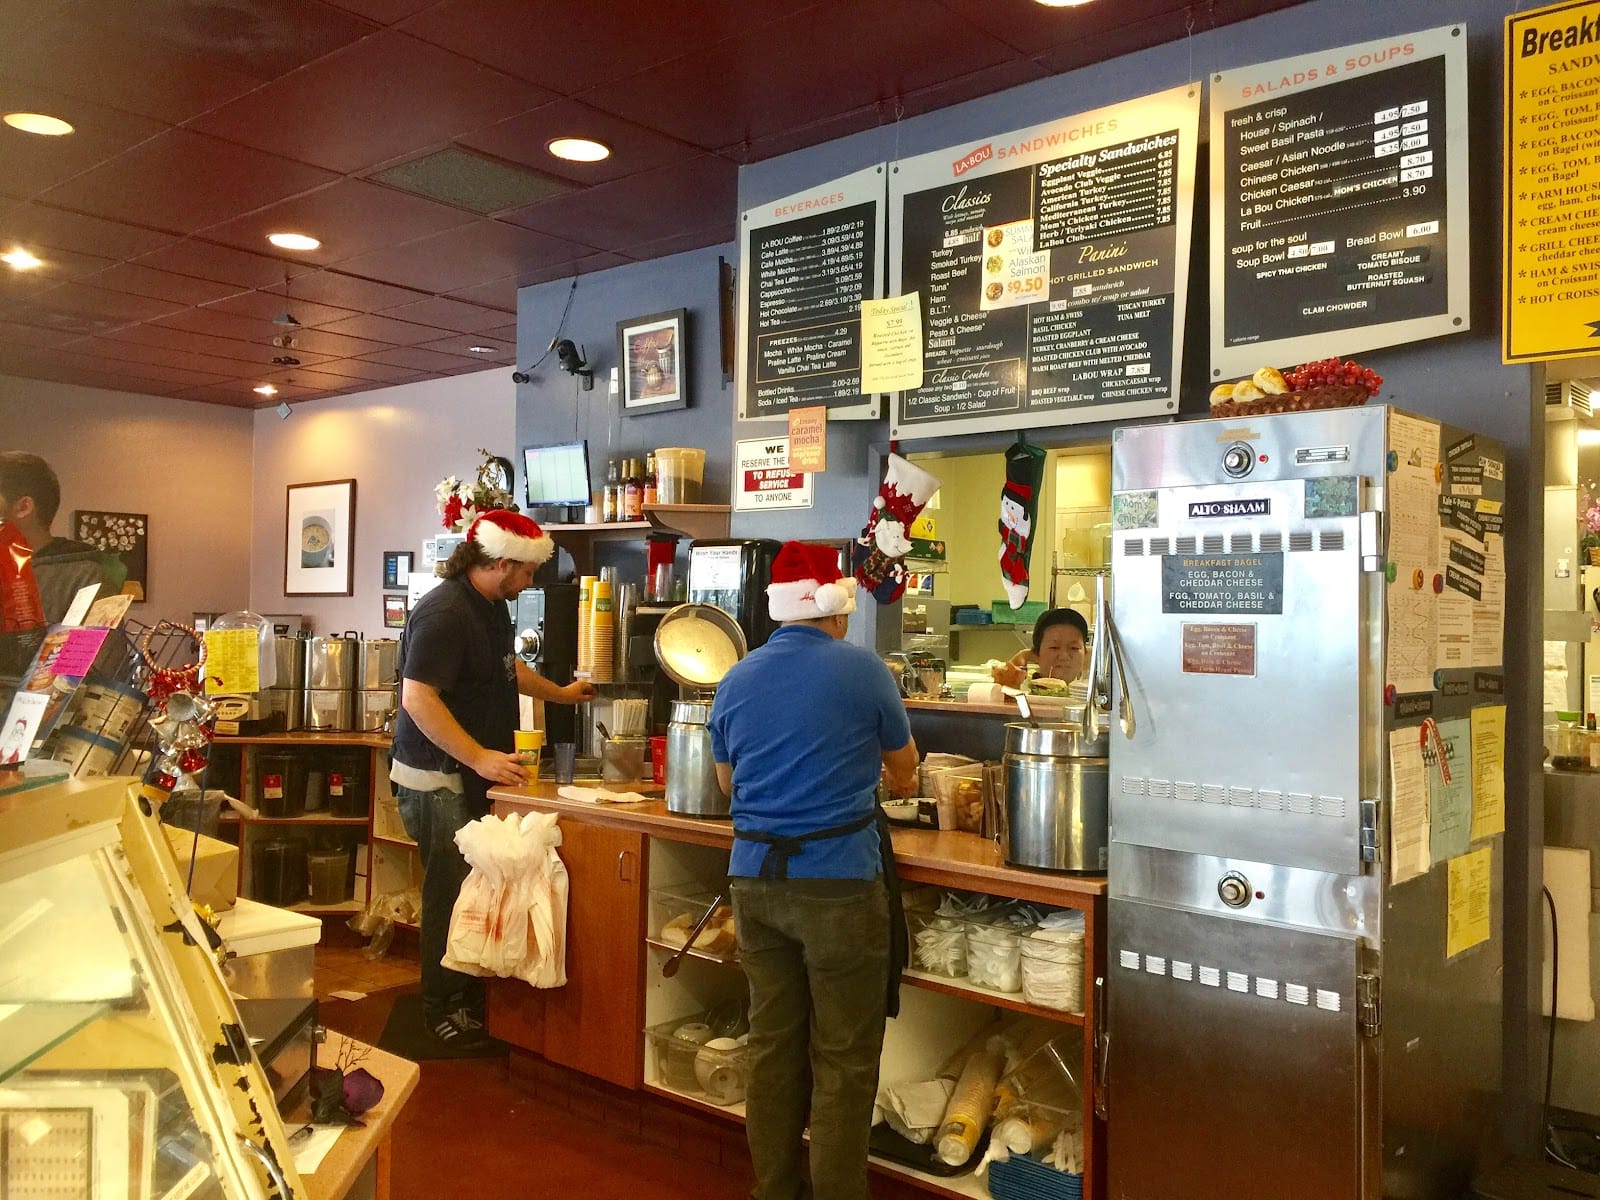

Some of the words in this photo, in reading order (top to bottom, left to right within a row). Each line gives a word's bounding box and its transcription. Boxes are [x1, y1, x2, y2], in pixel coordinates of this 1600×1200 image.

[1241, 68, 1318, 98] SALADS
[1345, 43, 1415, 71] SOUPS
[1552, 88, 1598, 104] Croissant
[1231, 115, 1253, 127] fresh
[1265, 107, 1288, 119] crisp
[1552, 114, 1598, 129] Croissant
[1240, 127, 1270, 140] House
[1278, 114, 1316, 132] Spinach
[997, 120, 1118, 159] SANDWICHES
[1240, 141, 1269, 156] Sweet
[1271, 134, 1295, 148] Basil
[1297, 129, 1325, 142] Pasta
[1039, 154, 1097, 177] Specialty
[1098, 135, 1178, 162] Sandwiches
[1538, 150, 1549, 158] on
[1553, 142, 1579, 155] Bagel
[1240, 158, 1274, 173] Caesar
[1281, 149, 1309, 163] Asian
[1311, 141, 1346, 156] Noodle
[1041, 175, 1075, 187] Eggplant
[1240, 172, 1279, 187] Chinese
[1280, 163, 1320, 178] Chicken
[1553, 170, 1579, 182] Bagel
[1040, 193, 1077, 206] American
[1080, 185, 1107, 197] Turkey
[1041, 184, 1073, 196] Avocado
[1240, 187, 1278, 202] Chicken
[1280, 178, 1315, 193] Caesar
[1240, 207, 1252, 217] La
[1254, 202, 1273, 214] Bou
[1275, 194, 1314, 209] Chicken
[1362, 176, 1398, 189] CHICKEN
[1531, 188, 1562, 201] FARM
[774, 192, 845, 217] BEVERAGES
[942, 185, 992, 213] Classics
[1040, 201, 1079, 214] California
[1082, 194, 1108, 205] Turkey
[1040, 205, 1097, 222] Mediterranean
[1098, 199, 1126, 211] Turkey
[1240, 219, 1261, 231] Fruit
[1402, 184, 1426, 197] 3.90
[1066, 222, 1097, 236] Teriyaki
[1100, 216, 1131, 228] Chicken
[1068, 214, 1099, 225] Chicken
[1530, 213, 1572, 227] CREAM
[1537, 226, 1567, 236] cream
[770, 238, 783, 248] BOU
[1231, 243, 1254, 255] soup
[1256, 239, 1268, 250] for
[1270, 236, 1285, 247] the
[1287, 232, 1307, 244] soul
[1346, 234, 1376, 248] Bread
[1378, 229, 1404, 242] Bowl
[1078, 241, 1128, 264] Panini
[1530, 240, 1566, 253] GRILL
[931, 248, 954, 259] Turkey
[1371, 250, 1405, 261] CREAMY
[1537, 250, 1577, 262] cheddar
[775, 257, 793, 266] Mocha
[931, 258, 958, 270] Smoked
[959, 254, 983, 265] Turkey
[1008, 254, 1046, 268] Alaskan
[1236, 256, 1260, 269] Soup
[1262, 252, 1285, 263] Bowl
[1357, 260, 1389, 270] TOMATO
[1390, 255, 1420, 266] BISQUE
[761, 271, 776, 279] White
[777, 267, 795, 276] Mocha
[930, 272, 950, 281] Roast
[951, 267, 967, 277] Beef
[1010, 265, 1046, 278] Salmon
[1067, 269, 1105, 281] GRILLED
[1107, 259, 1159, 274] SANDWICH
[1295, 263, 1328, 274] CHICKEN
[1530, 267, 1557, 278] HAM
[1560, 265, 1568, 274] &
[1367, 271, 1403, 280] ROASTED
[1537, 280, 1549, 288] on
[1552, 273, 1598, 286] Croissant
[1008, 277, 1043, 294] $9.50
[1347, 280, 1391, 291] BUTTERNUT
[1392, 276, 1425, 286] SQUASH
[761, 288, 792, 298] Cappuccino
[930, 295, 946, 304] Ham
[1530, 294, 1554, 304] HOT
[761, 299, 785, 308] Espresso
[1118, 302, 1140, 311] TUSCAN
[1141, 298, 1166, 308] TURKEY
[1302, 306, 1325, 315] CLAM
[1326, 301, 1367, 312] CHOWDER
[770, 306, 797, 316] Chocolate
[1117, 313, 1132, 321] TUNA
[1134, 310, 1151, 319] MELT
[930, 316, 952, 327] Veggie
[1050, 321, 1077, 332] CHICKEN
[930, 329, 948, 338] Pesto
[1033, 334, 1059, 343] ROASTED
[1060, 329, 1091, 340] EGGPLANT
[769, 337, 797, 346] FREEZES
[928, 336, 956, 348] Salami
[1056, 339, 1089, 350] CRANBERRY
[1117, 332, 1139, 341] CHEESE
[764, 350, 782, 358] Mocha
[787, 346, 802, 355] White
[804, 343, 823, 352] Mocha
[828, 338, 853, 348] Caramel
[1032, 353, 1058, 363] ROASTED
[1059, 351, 1085, 360] CHICKEN
[1118, 342, 1148, 352] AVOCADO
[768, 358, 786, 367] Praline
[827, 350, 846, 358] Cream
[1072, 371, 1099, 381] LABOU
[1100, 368, 1123, 378] WRAP
[941, 392, 972, 402] Sandwich
[1101, 390, 1126, 399] CHINESE
[1126, 388, 1153, 397] CHICKEN
[968, 401, 986, 409] Salad
[791, 424, 823, 436] caramel
[794, 436, 820, 445] mocha
[765, 445, 784, 454] WE
[741, 458, 770, 469] RESERVE
[773, 457, 785, 465] THE
[753, 471, 763, 480] TO
[766, 469, 797, 479] REFUS
[759, 479, 790, 490] SERVICE
[755, 494, 763, 502] TO
[766, 492, 792, 501] ANYONE
[1191, 501, 1265, 516] ALTO-SHAAM
[1183, 559, 1231, 567] BREAKFAST
[1234, 559, 1262, 567] BAGEL
[1188, 571, 1210, 579] EGG,
[1213, 570, 1245, 578] BACON
[1180, 579, 1223, 587] CHEDDAR
[1226, 579, 1263, 587] CHEESE
[1194, 592, 1234, 601] TOMATO,
[1237, 592, 1265, 600] BASIL
[1226, 600, 1263, 608] CHEESE
